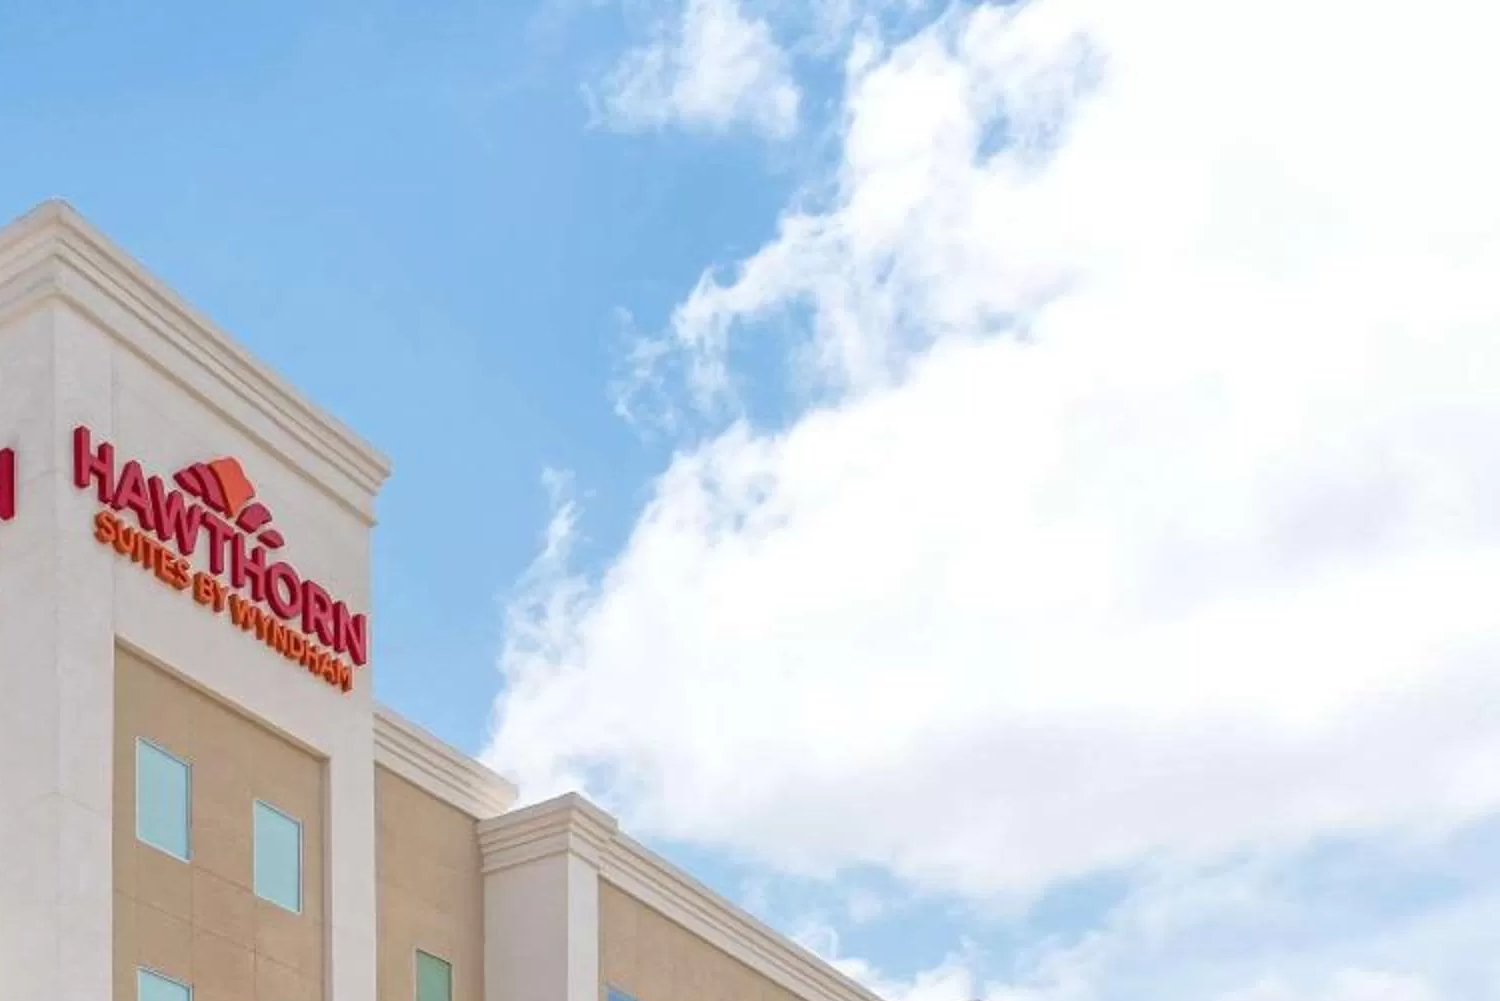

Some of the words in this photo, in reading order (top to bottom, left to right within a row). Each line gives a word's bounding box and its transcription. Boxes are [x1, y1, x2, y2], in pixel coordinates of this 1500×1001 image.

[73, 426, 367, 666] HAWTHORN
[94, 511, 191, 590] SUITES
[193, 571, 230, 612] BY
[228, 594, 352, 692] WYNDHAM
